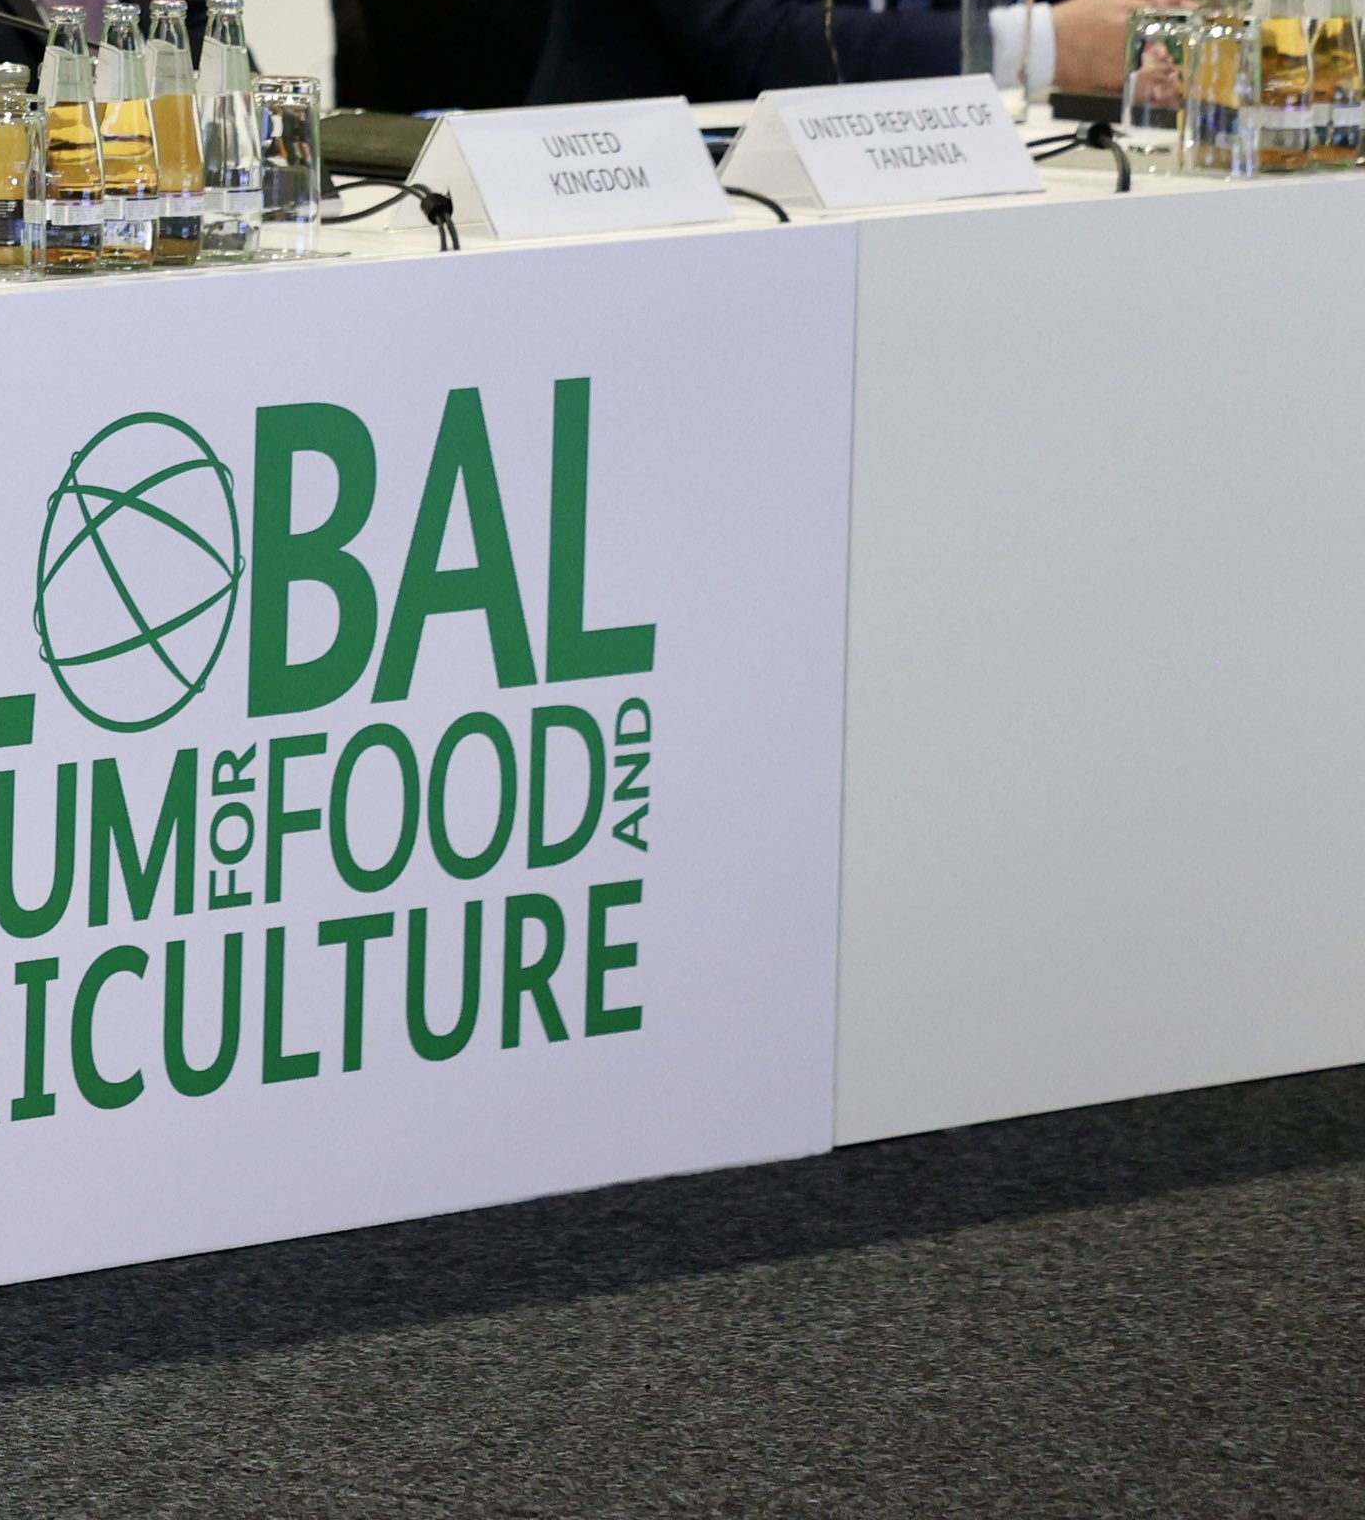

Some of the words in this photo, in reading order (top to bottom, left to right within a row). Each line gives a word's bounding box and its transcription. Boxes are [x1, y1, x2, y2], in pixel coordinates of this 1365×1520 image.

[798, 113, 874, 140] UNITED
[873, 105, 967, 134] REPUBLIC
[967, 102, 993, 127] OF
[542, 131, 622, 159] UNITED
[864, 141, 967, 171] TANZANIA
[548, 165, 651, 196] KINGDOM
[209, 744, 257, 910] FOR
[265, 705, 606, 904] FOOD
[612, 697, 652, 852] AND
